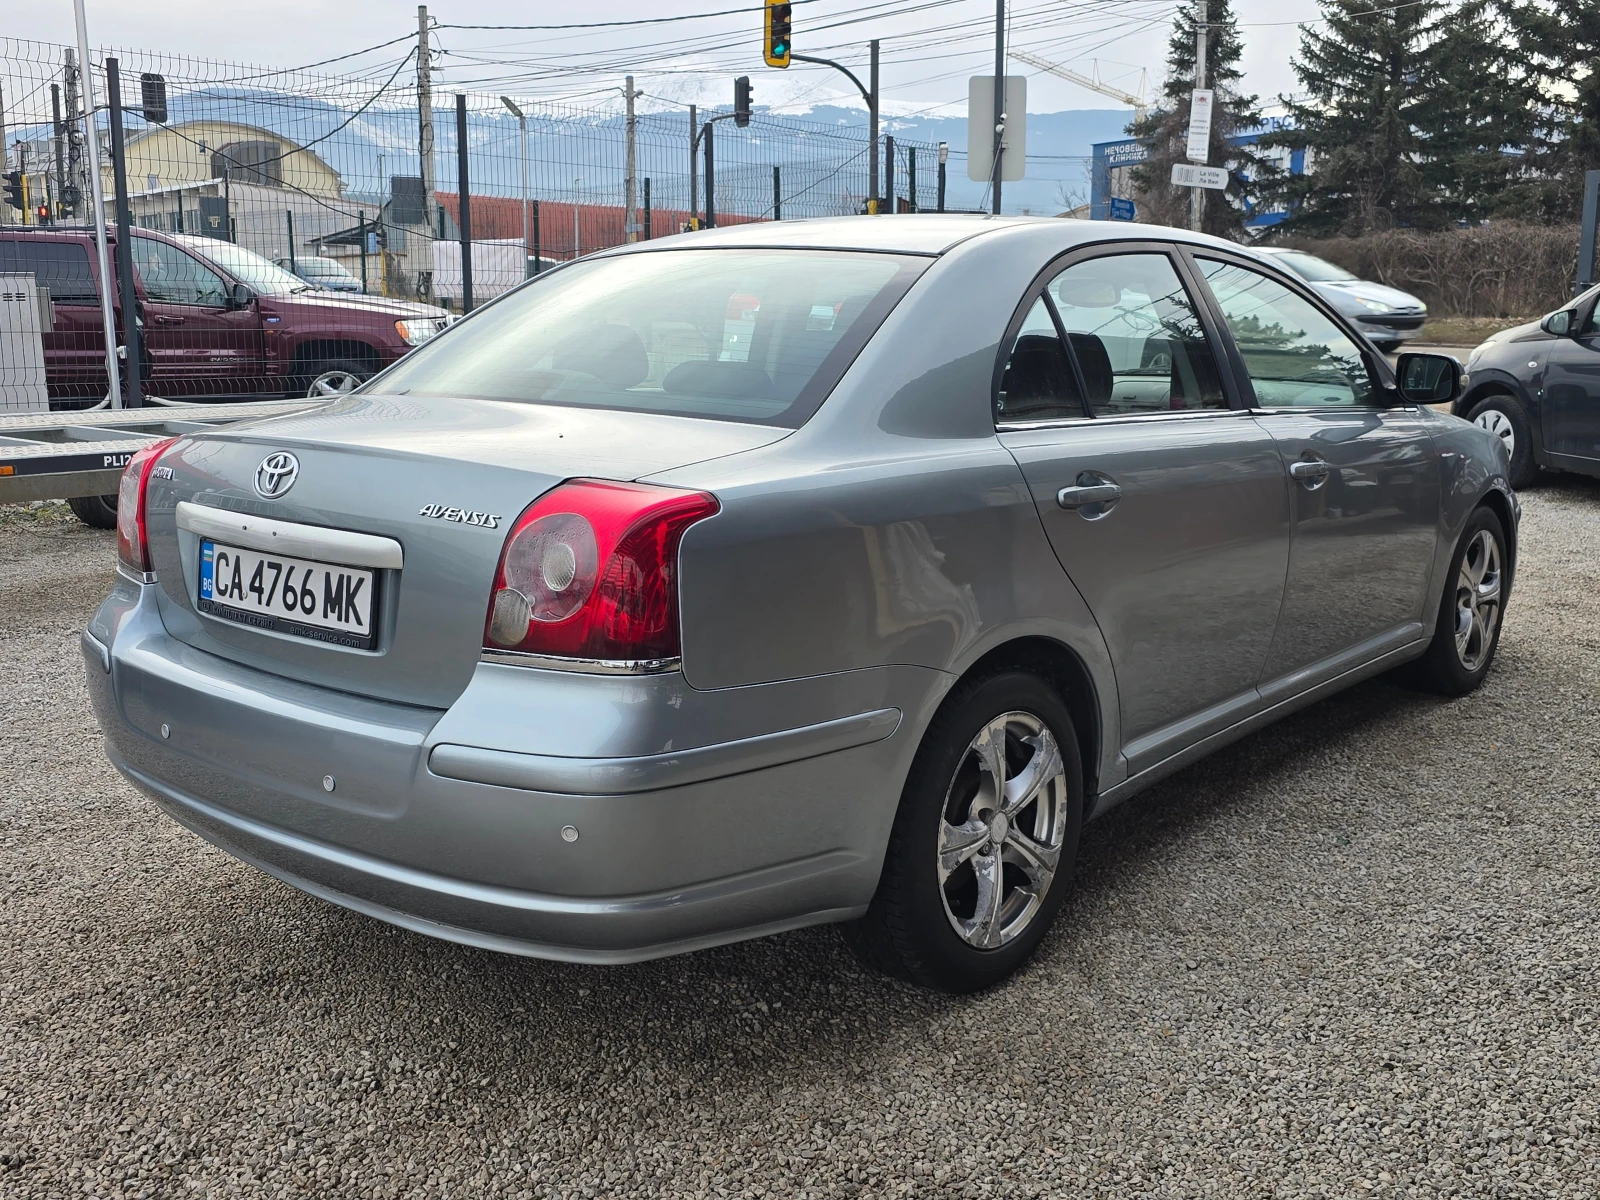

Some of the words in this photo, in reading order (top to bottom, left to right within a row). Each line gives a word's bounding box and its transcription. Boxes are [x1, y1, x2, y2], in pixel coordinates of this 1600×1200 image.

[1109, 151, 1148, 163] КЛИНИКА
[418, 503, 502, 529] AVENSIS
[203, 578, 212, 592] BG
[215, 552, 244, 601] CA
[249, 559, 316, 616] 4766
[322, 571, 365, 626] MK
[289, 625, 360, 648] emk-service.com
